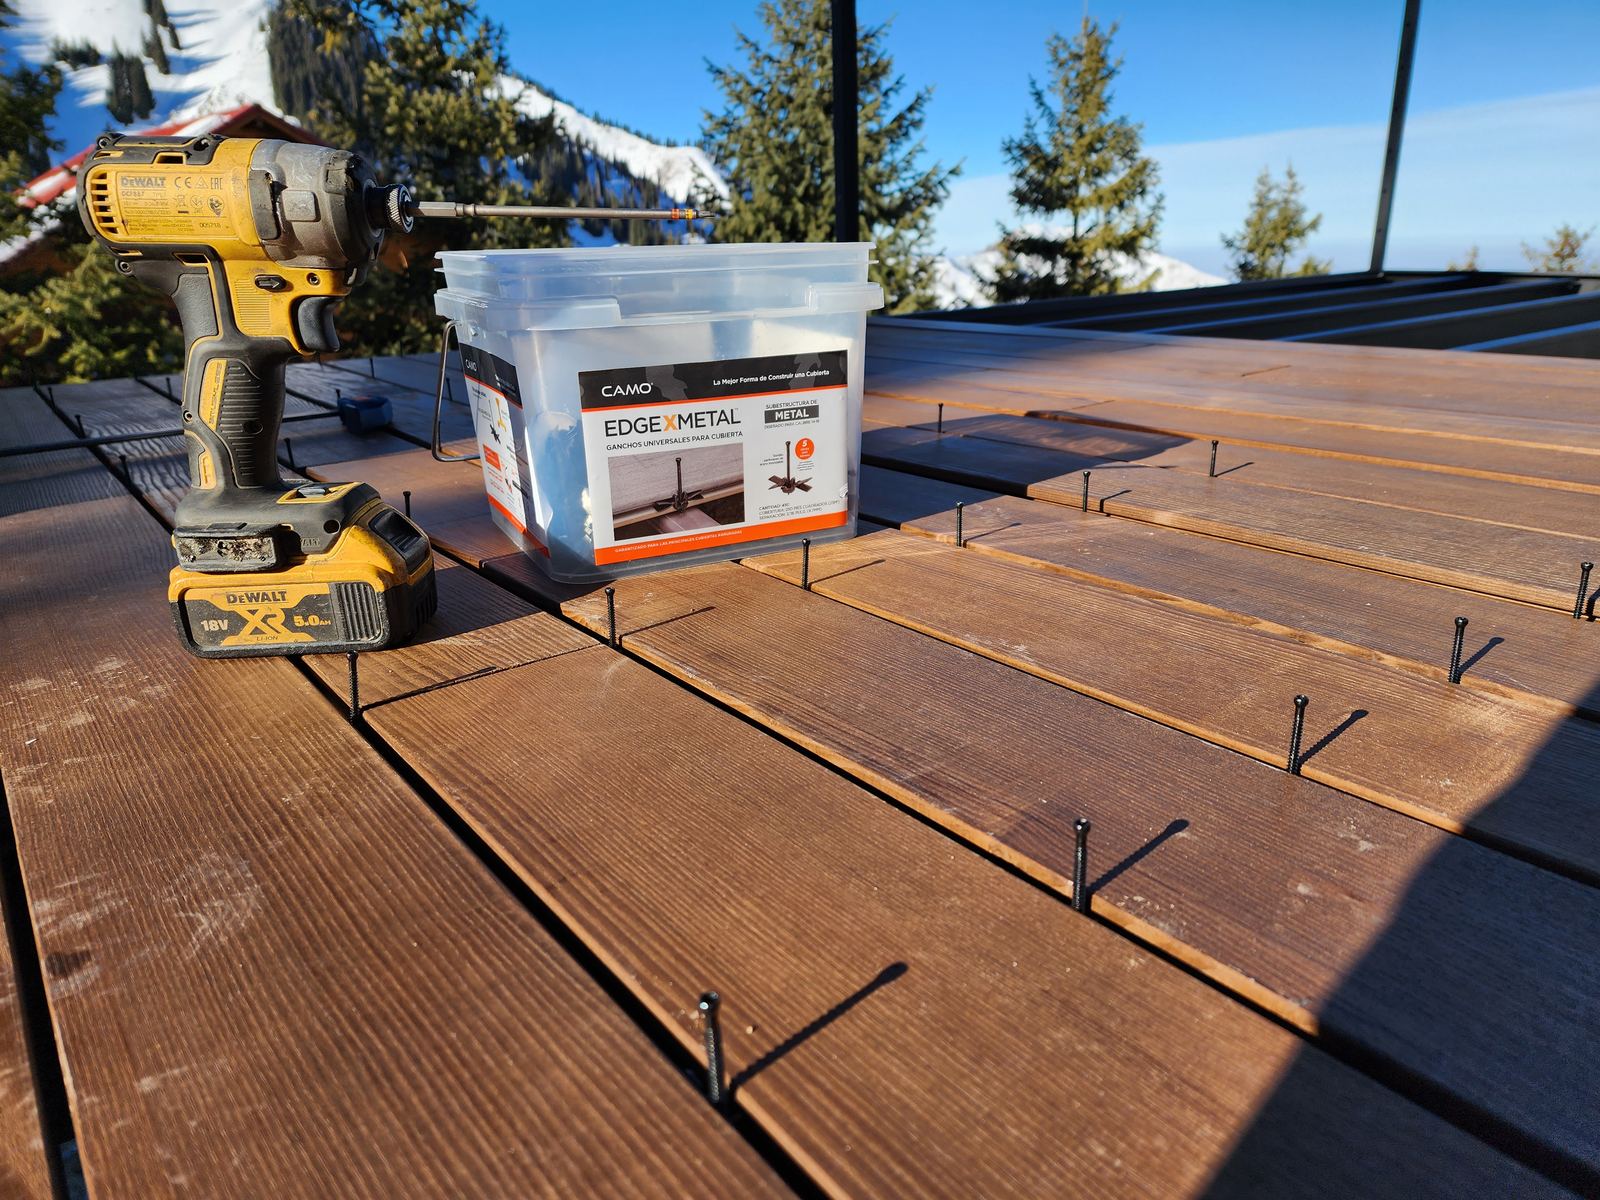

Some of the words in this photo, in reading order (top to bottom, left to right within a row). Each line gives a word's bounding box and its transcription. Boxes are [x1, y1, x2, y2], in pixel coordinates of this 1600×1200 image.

[120, 176, 166, 187] DEWALT
[722, 378, 739, 386] Mejor
[740, 376, 759, 384] Forma
[768, 372, 794, 381] Construir
[806, 369, 830, 377] Cubierta
[601, 382, 653, 397] CAMO
[765, 400, 810, 409] SUBESTRUCTURA
[775, 408, 810, 421] METAL
[606, 441, 643, 451] GANCHOS
[643, 436, 691, 447] UNIVERSALES
[692, 434, 710, 442] PARA
[711, 431, 743, 440] CUBIERTA
[226, 590, 287, 604] DEWALT
[201, 619, 229, 632] 18V
[236, 608, 292, 634] XR
